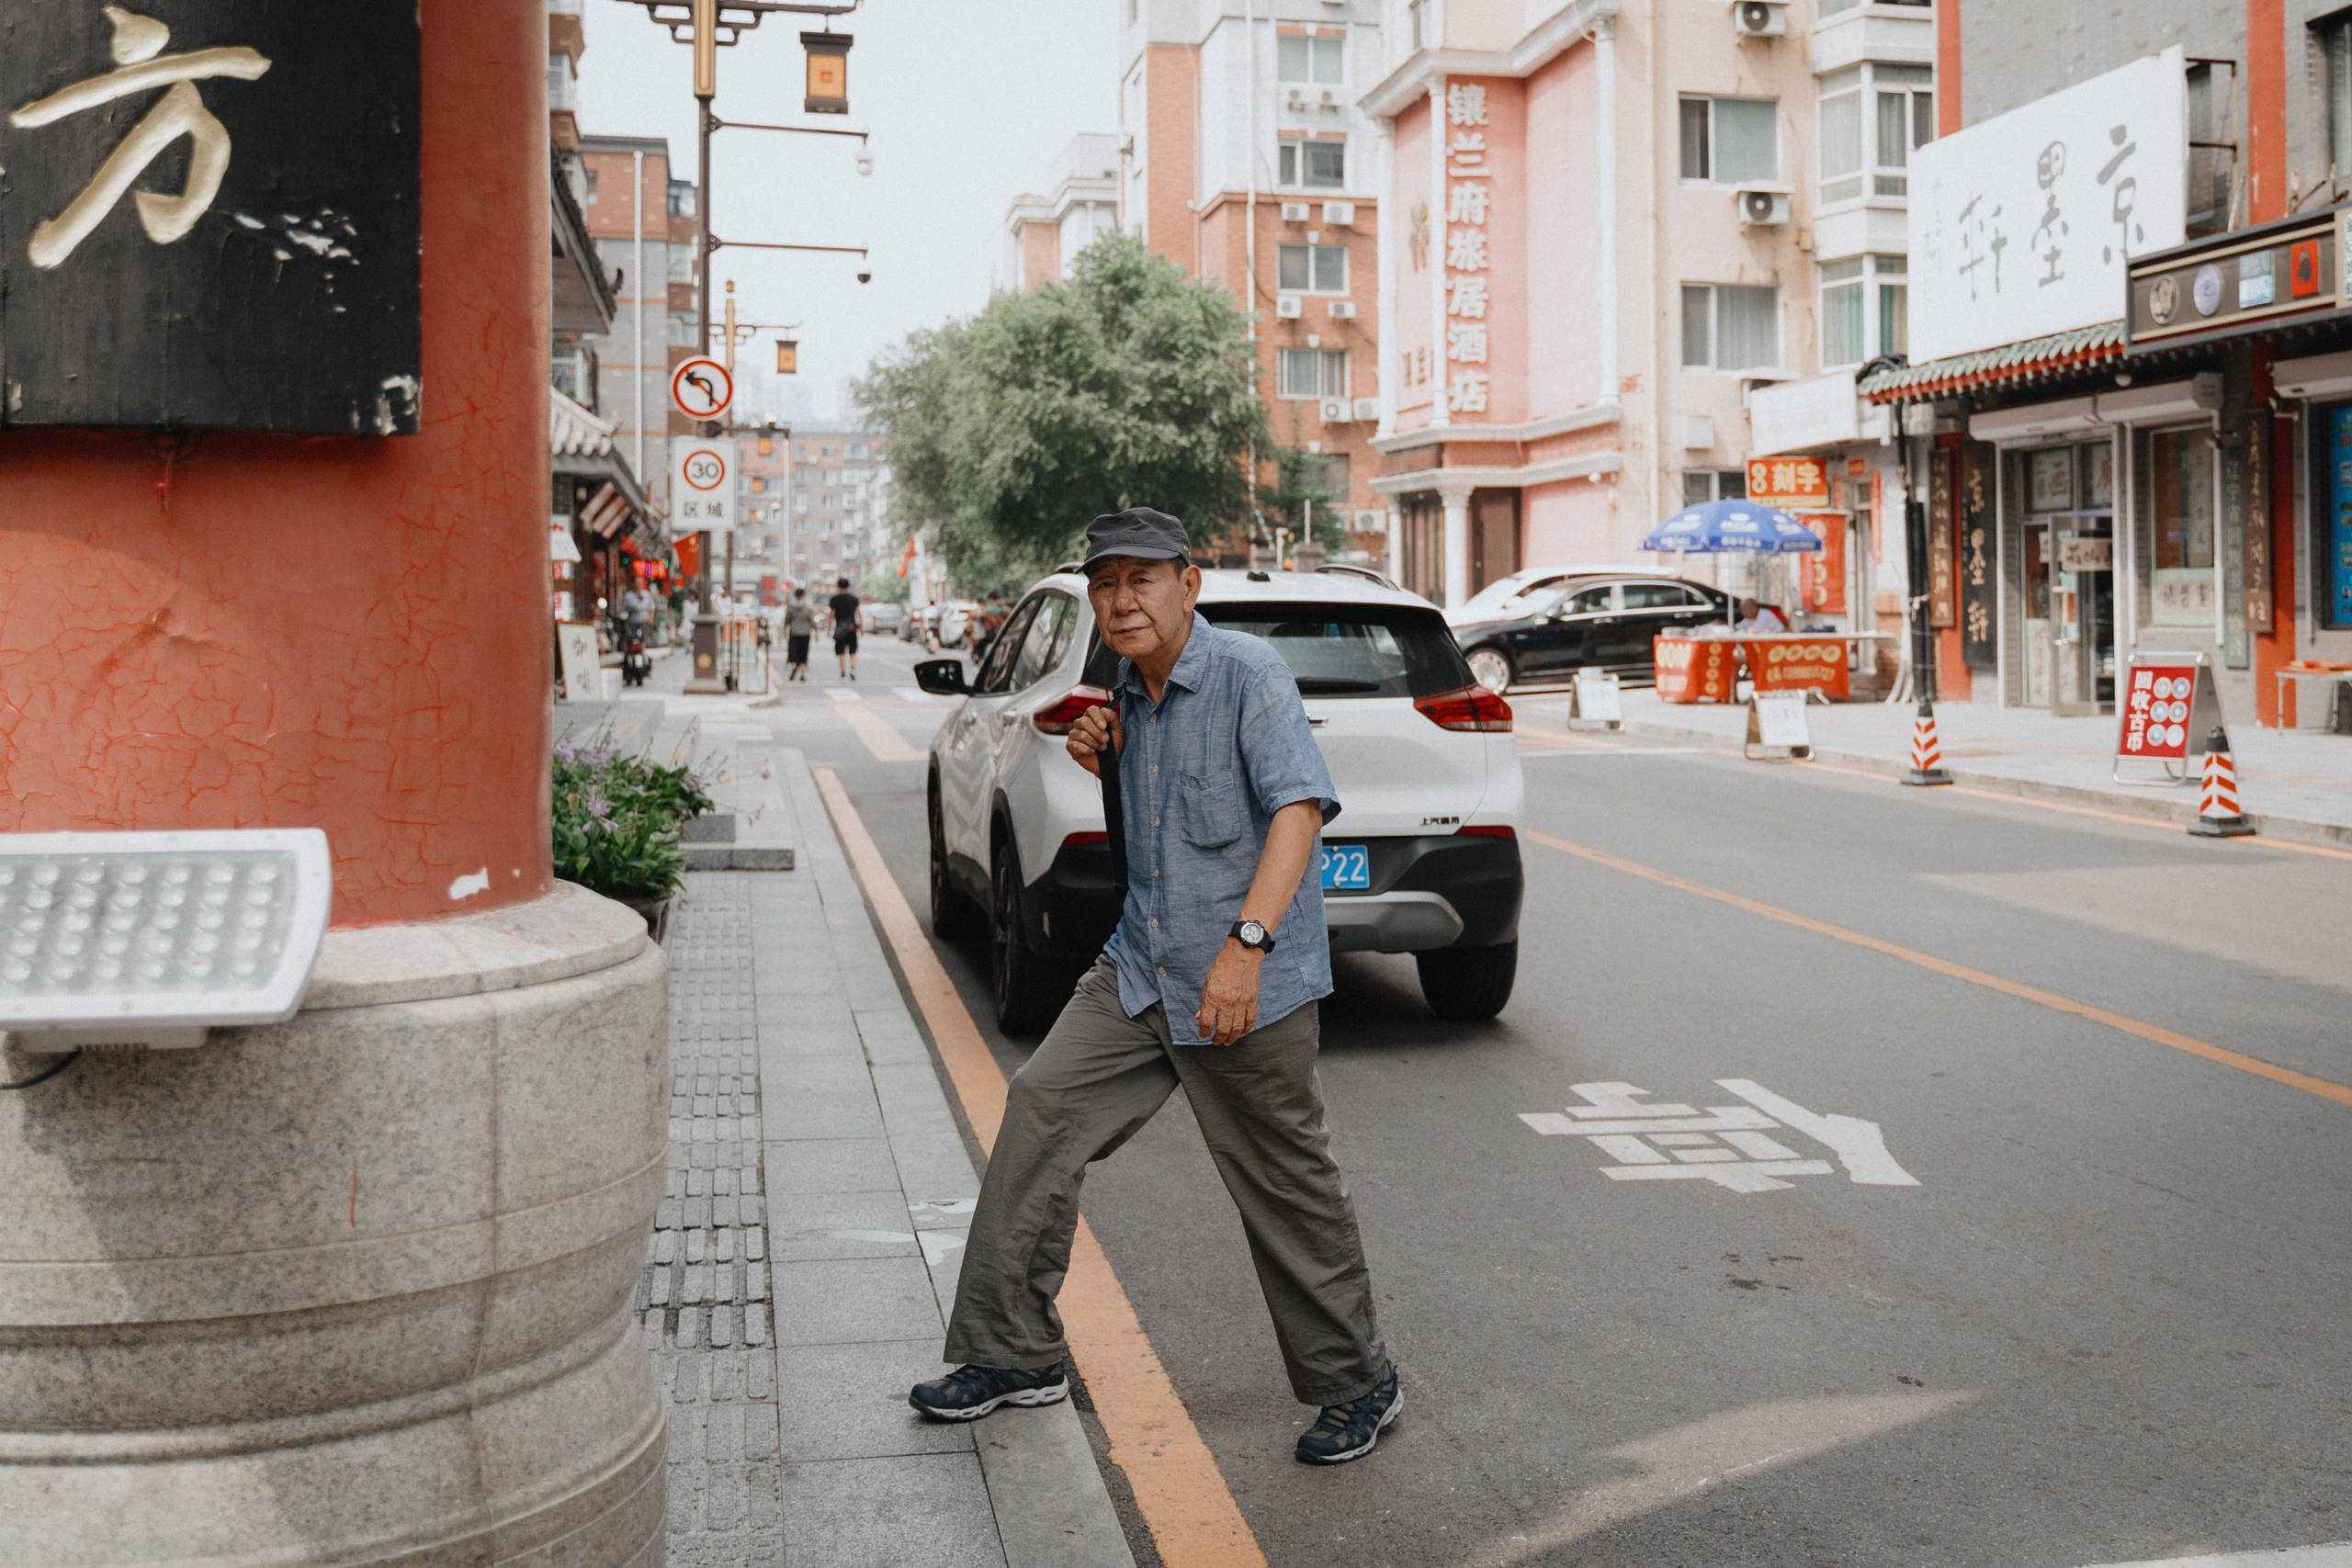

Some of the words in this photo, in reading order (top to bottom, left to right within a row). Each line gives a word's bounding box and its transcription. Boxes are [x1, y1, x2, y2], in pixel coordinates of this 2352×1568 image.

[10, 6, 272, 269] 方
[691, 462, 720, 479] 30
[1771, 462, 1822, 493] 刻字
[684, 502, 723, 518] 区域
[2126, 670, 2153, 752] 回收古币
[1420, 816, 1460, 826] 上汽通用
